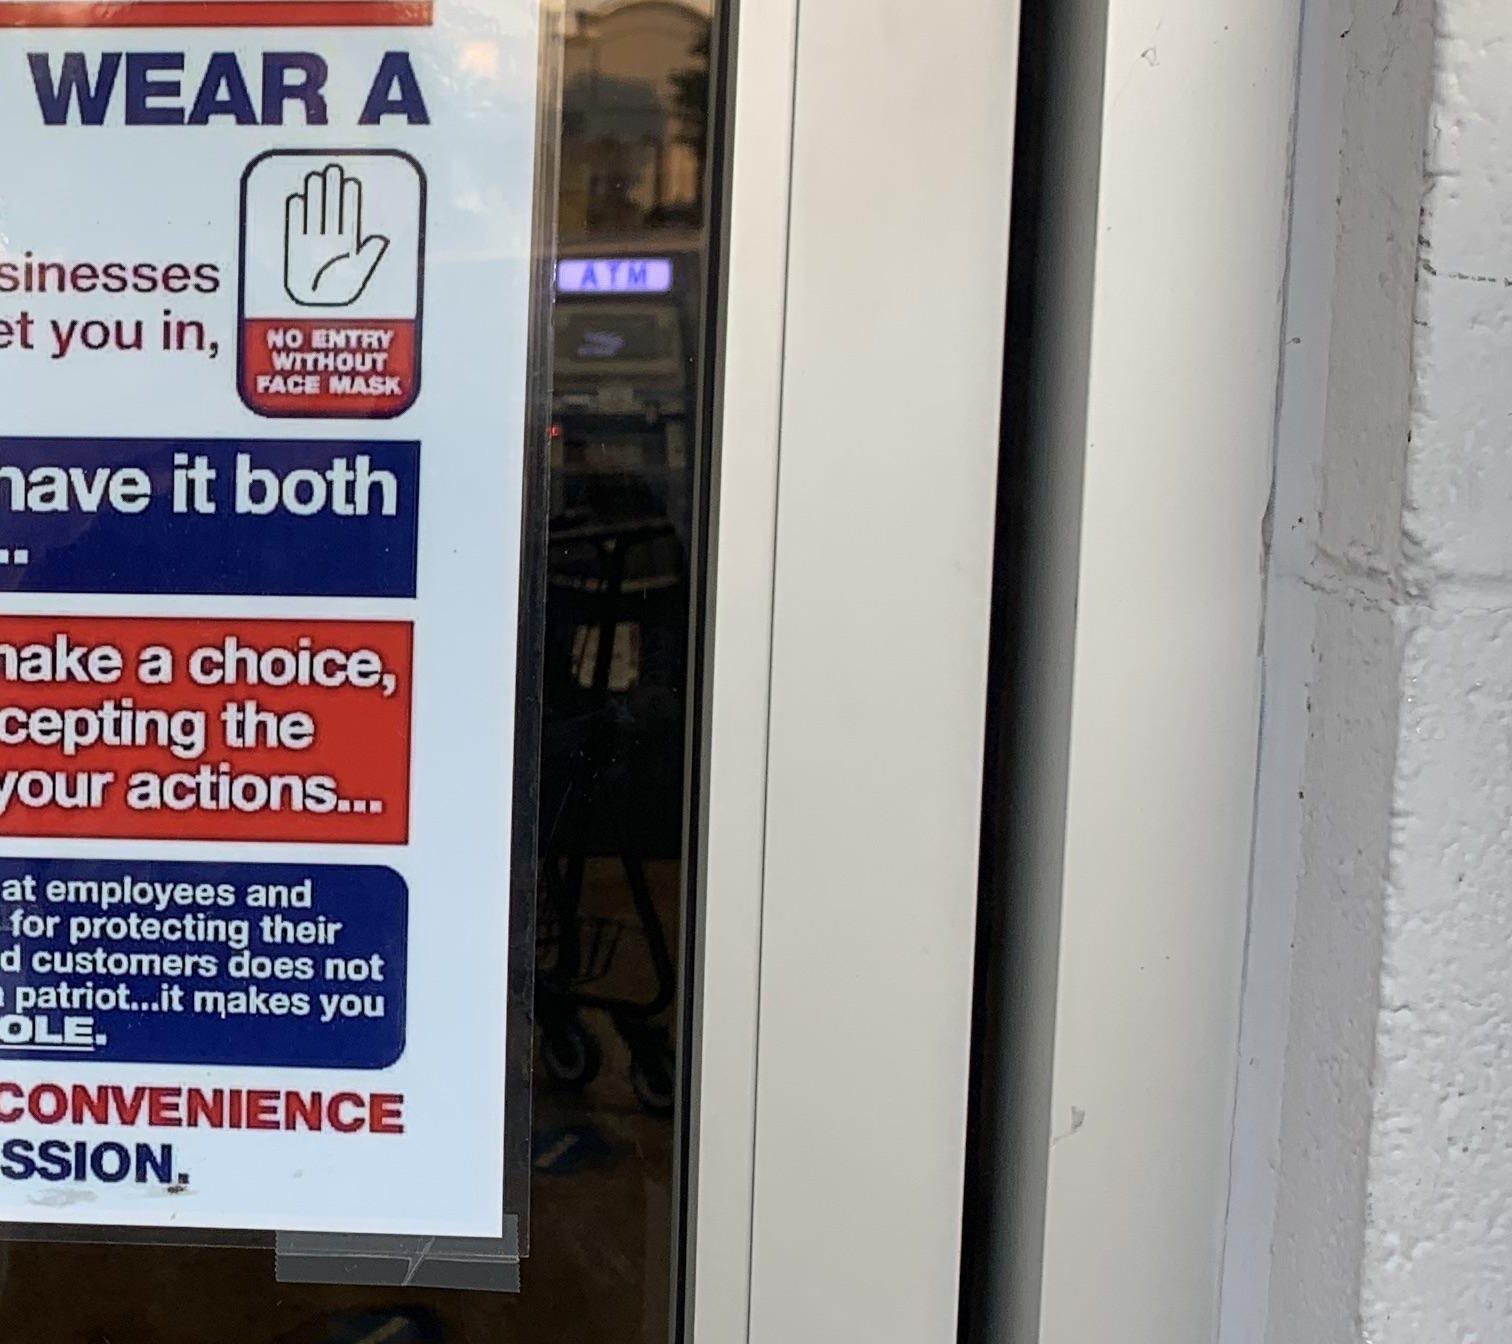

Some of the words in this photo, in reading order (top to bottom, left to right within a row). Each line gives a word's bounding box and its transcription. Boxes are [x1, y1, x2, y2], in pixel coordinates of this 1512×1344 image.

[26, 49, 329, 125] WEAR
[356, 49, 430, 125] A
[580, 264, 647, 288] ATM
[50, 318, 142, 361] you
[157, 311, 220, 361] in,
[267, 328, 303, 349] NO
[312, 329, 394, 349] ENTRY
[272, 352, 387, 371] WITHOUT
[256, 375, 320, 393] FACE
[329, 376, 401, 395] MASK
[172, 454, 217, 513] it
[235, 454, 397, 516] both
[138, 646, 172, 685] a
[190, 636, 397, 696] choice,
[220, 702, 314, 748] the
[128, 766, 382, 813] actions...
[3, 873, 37, 904] at
[45, 873, 234, 913] employees
[247, 875, 311, 908] and
[11, 910, 59, 940] for
[70, 912, 250, 951] protecting
[261, 914, 340, 945] their
[31, 947, 217, 978] customers
[228, 948, 310, 980] does
[325, 951, 382, 981] not
[15, 980, 187, 1018] patriot...it
[194, 985, 308, 1017] makes
[319, 992, 384, 1022] you
